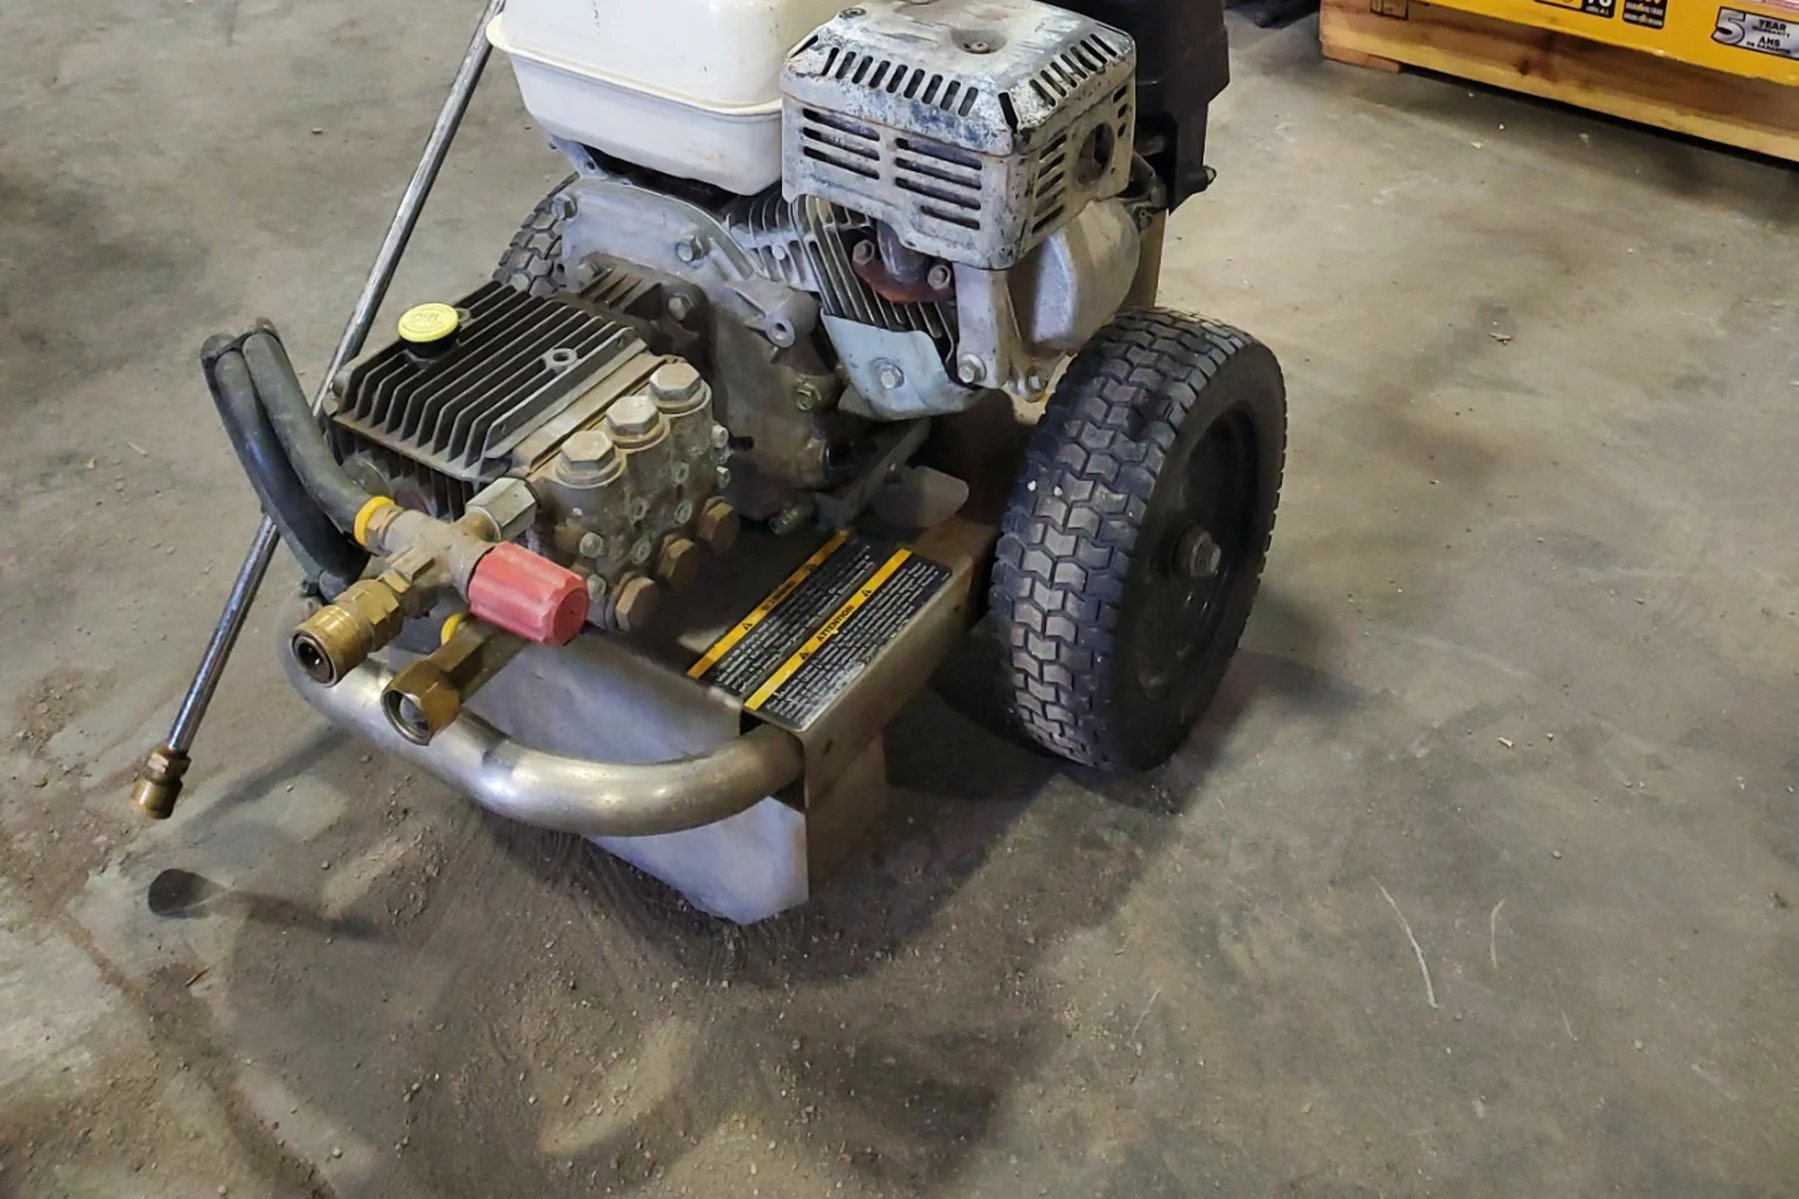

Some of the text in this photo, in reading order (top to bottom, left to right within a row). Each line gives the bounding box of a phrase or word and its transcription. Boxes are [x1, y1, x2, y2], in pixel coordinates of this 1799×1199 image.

[1711, 6, 1746, 46] 5
[1758, 19, 1787, 31] YEAR
[1758, 36, 1781, 47] ANS
[816, 604, 855, 642] ATTENTION
